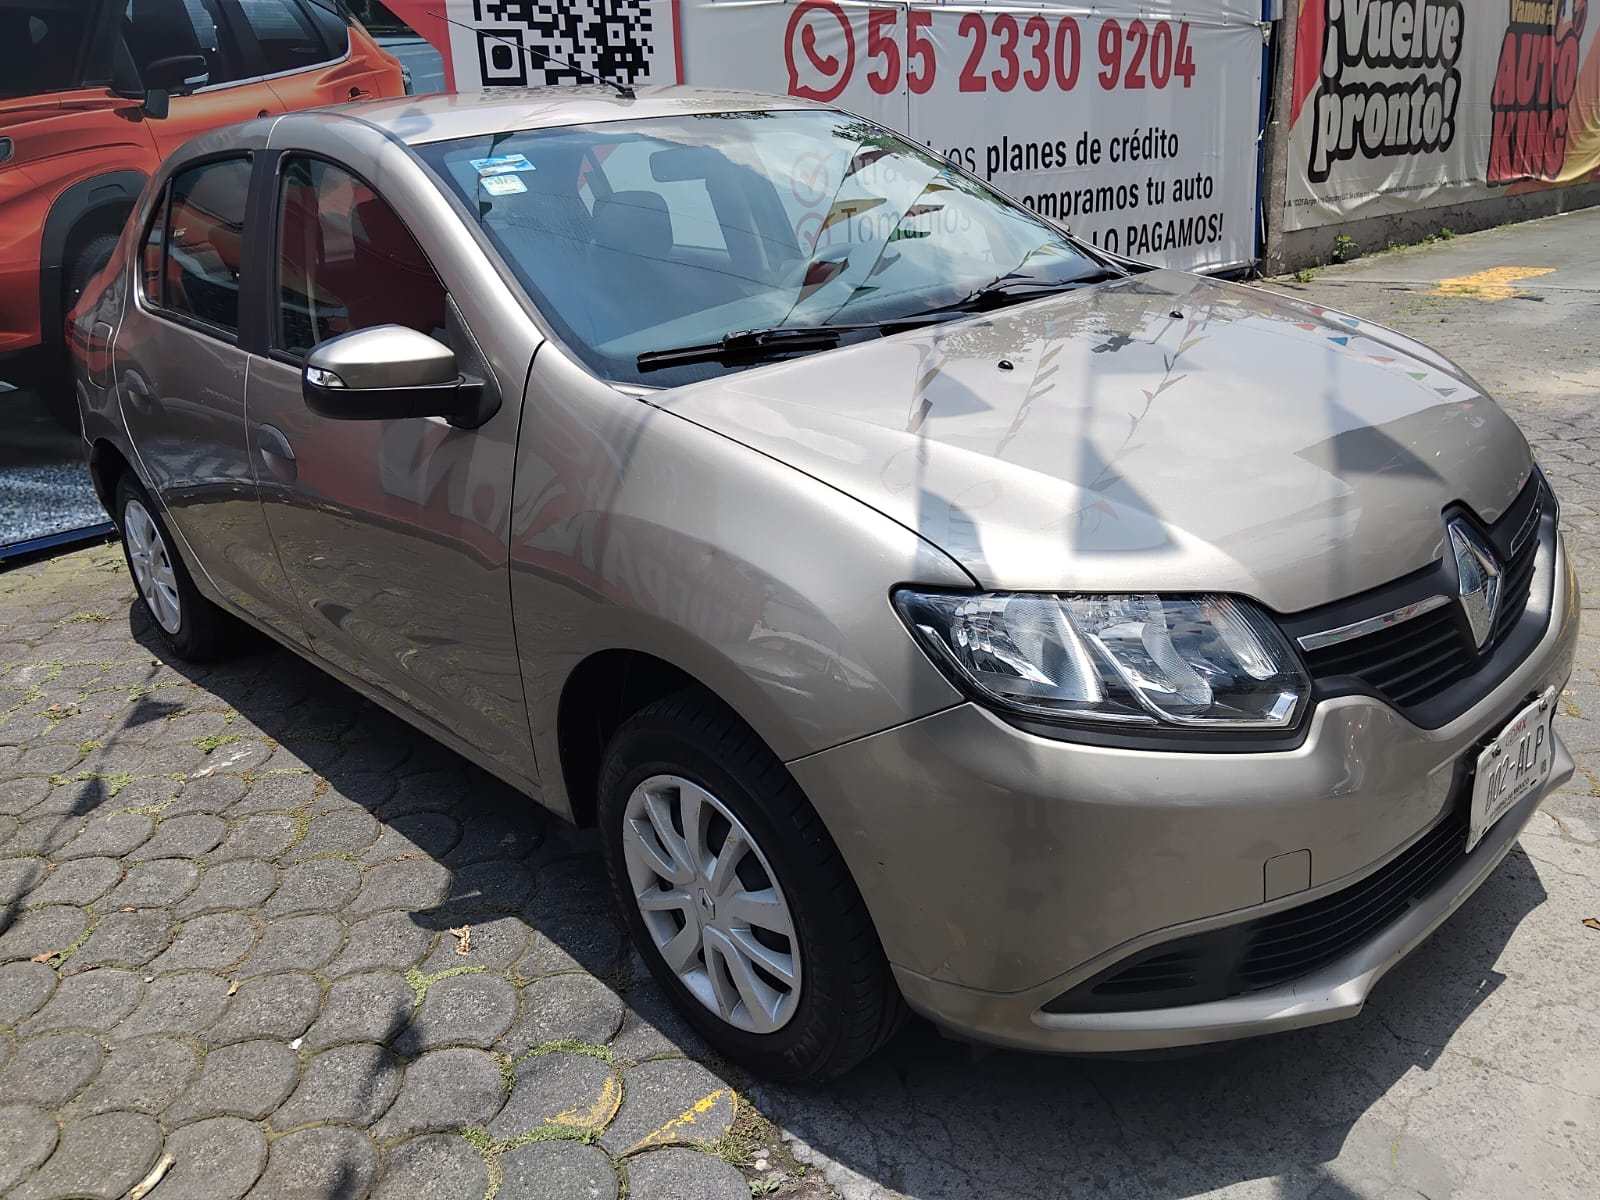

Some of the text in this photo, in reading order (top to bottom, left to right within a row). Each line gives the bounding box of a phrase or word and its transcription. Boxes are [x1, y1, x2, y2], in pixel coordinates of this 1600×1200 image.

[866, 9, 1196, 95] 55 2330 9204
[1491, 29, 1579, 107] AUTO
[985, 137, 1067, 180] planes
[1075, 131, 1102, 166] de
[1108, 126, 1180, 162] crédito
[1308, 72, 1462, 183] pronto!
[1486, 107, 1569, 187] KING
[1016, 182, 1140, 221] ompramos
[1145, 176, 1166, 206] tu
[1172, 172, 1214, 203] auto
[1126, 212, 1225, 257] PAGAMOS!
